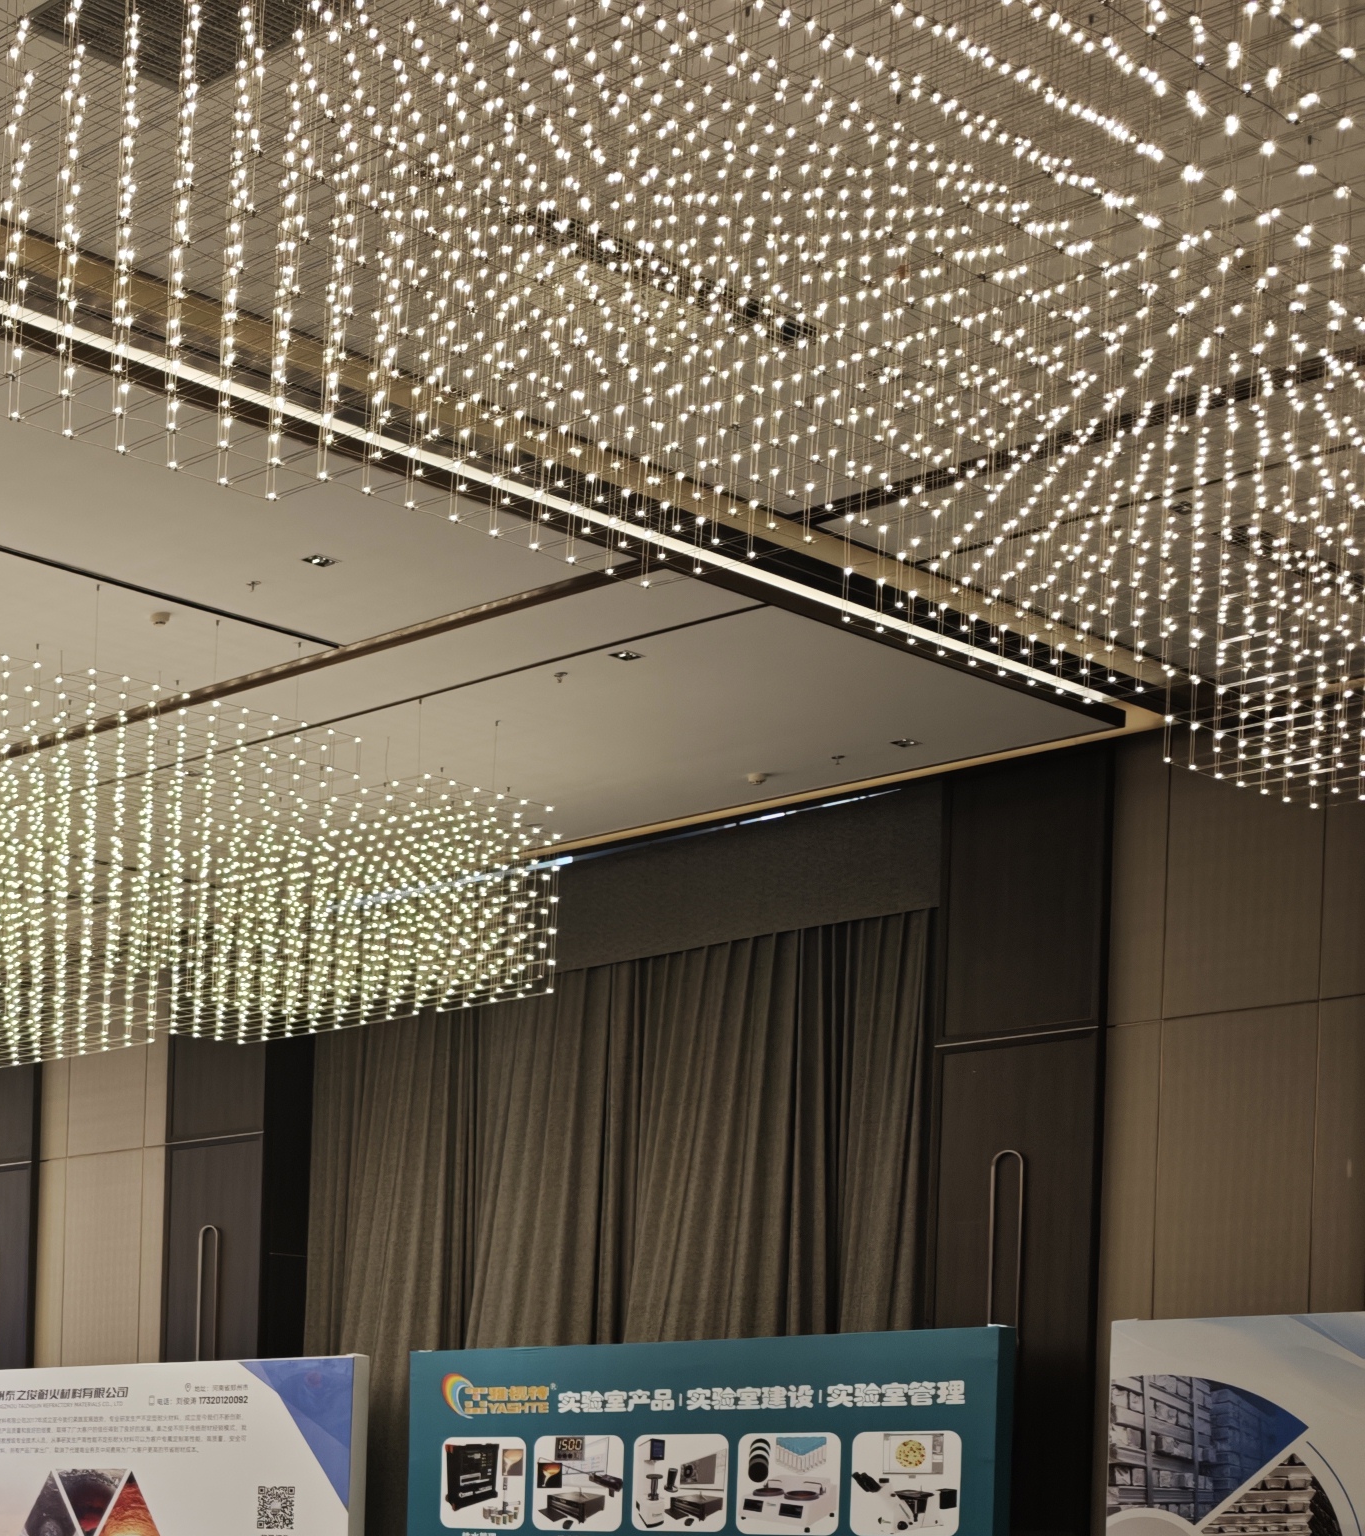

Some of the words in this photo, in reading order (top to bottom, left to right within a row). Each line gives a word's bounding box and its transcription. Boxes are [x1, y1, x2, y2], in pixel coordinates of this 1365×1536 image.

[557, 1388, 675, 1414] 实验室产品
[686, 1385, 814, 1411] 实验室建设
[826, 1380, 966, 1408] 实验室管理
[487, 1402, 550, 1414] YASHTE
[557, 1439, 583, 1451] 1500
